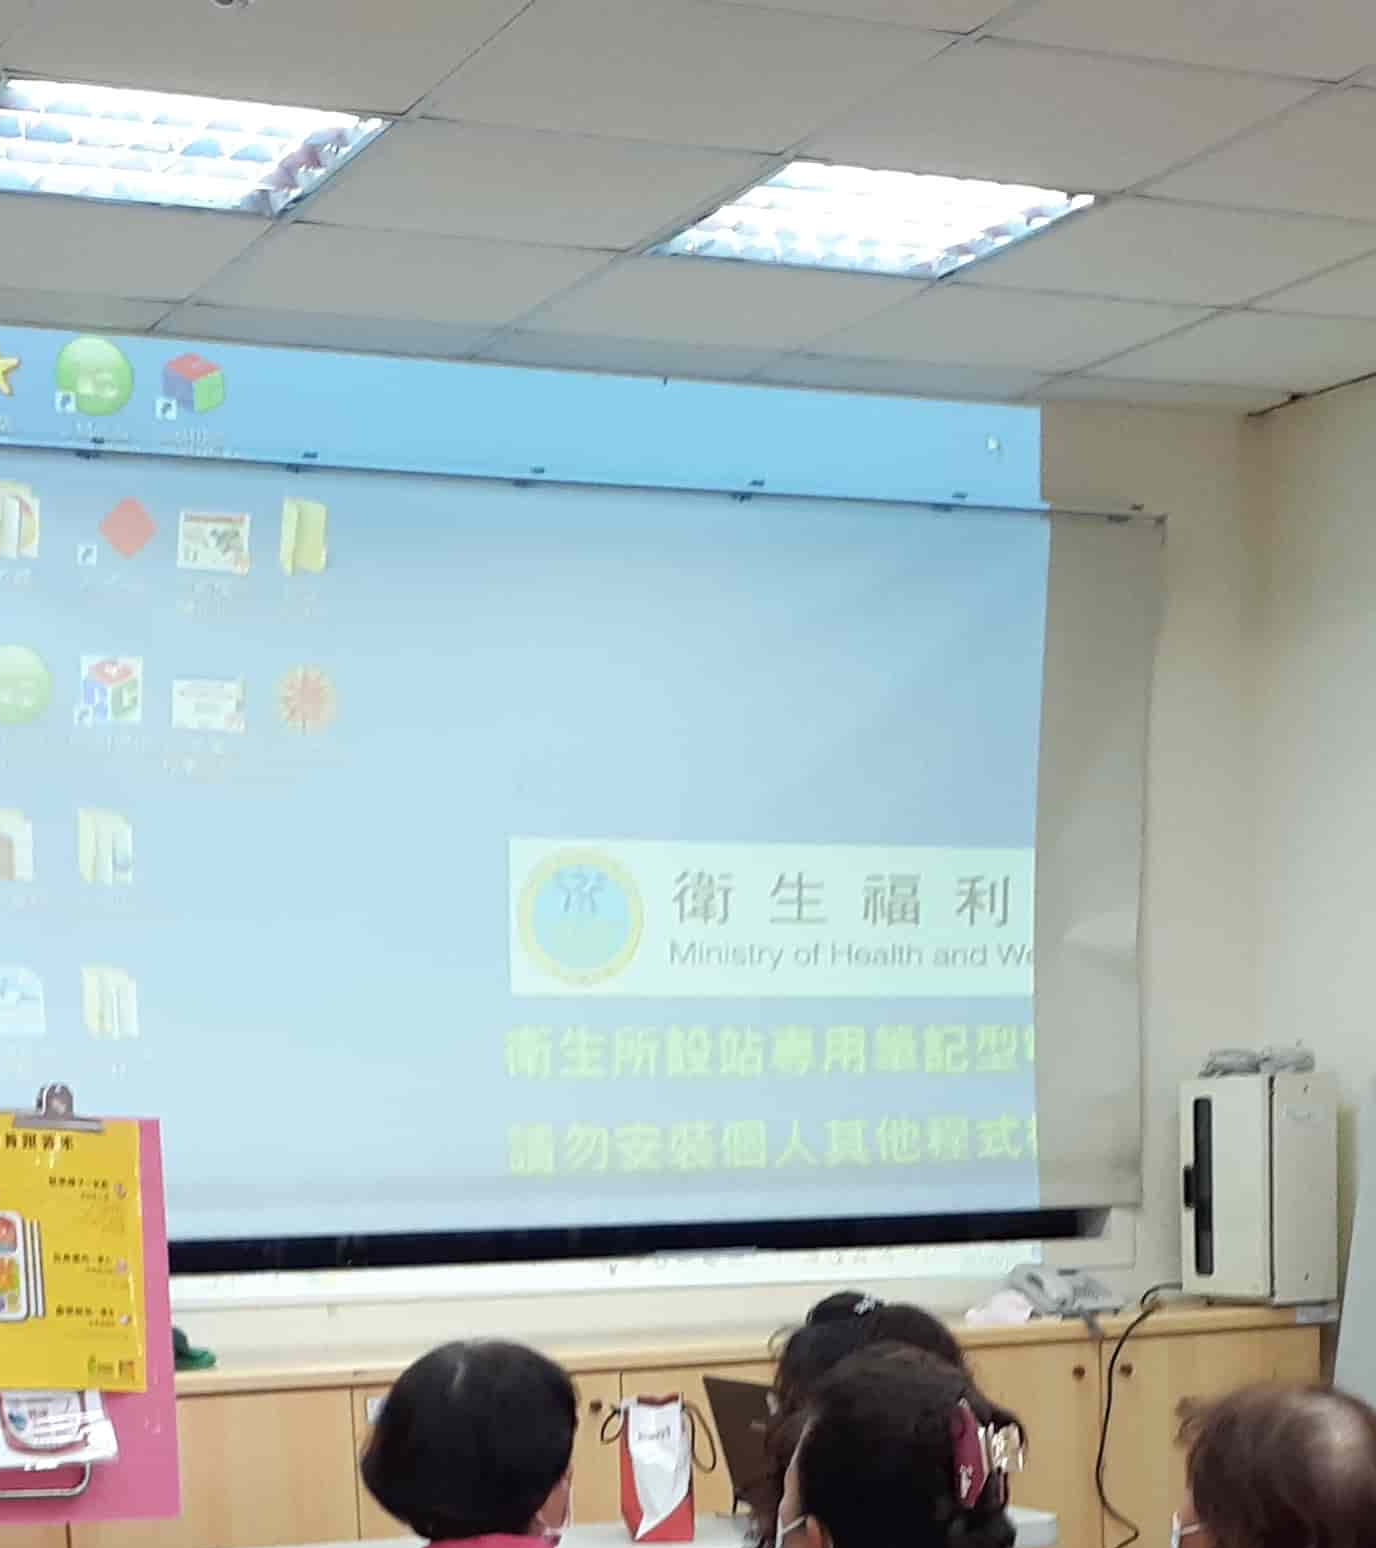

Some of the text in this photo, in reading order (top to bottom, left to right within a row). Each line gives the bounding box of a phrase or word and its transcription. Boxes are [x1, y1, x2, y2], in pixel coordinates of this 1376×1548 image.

[669, 940, 784, 972] Ministry
[793, 940, 821, 966] of
[831, 940, 924, 967] Health
[933, 942, 987, 967] and
[504, 1023, 1035, 1080] 衛生所設站專用筆記型
[508, 1112, 1038, 1176] 請勿安裝個人其他程式
